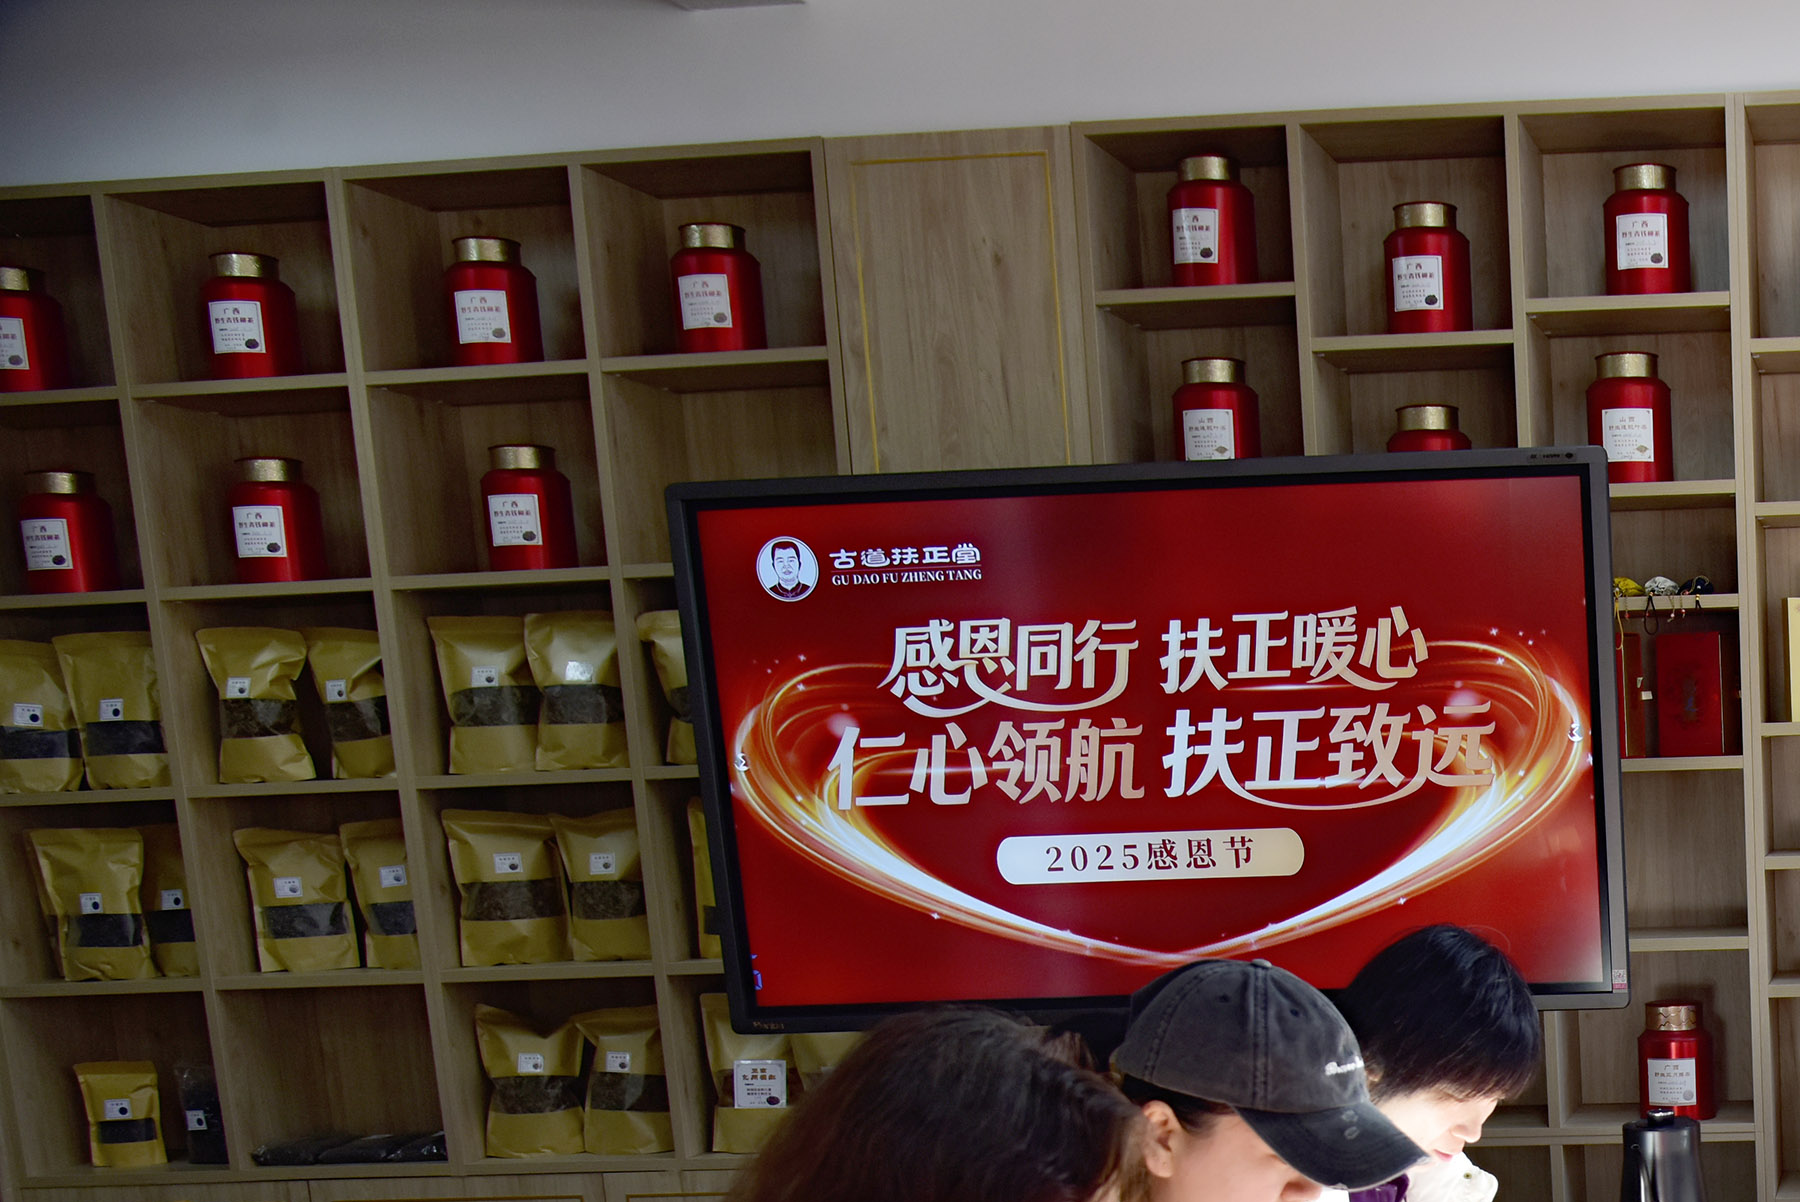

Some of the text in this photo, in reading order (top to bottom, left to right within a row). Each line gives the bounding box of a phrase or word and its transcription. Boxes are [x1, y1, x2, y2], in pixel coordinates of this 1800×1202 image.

[829, 543, 981, 569] 古道扶正堂
[832, 569, 982, 585] GU DAO FU ZHENG TANG
[877, 605, 1428, 719] 感恩同行 扶正暖心
[826, 700, 1496, 811] 仁心领航 扶正致远
[1045, 836, 1255, 873] 2025感恩节
